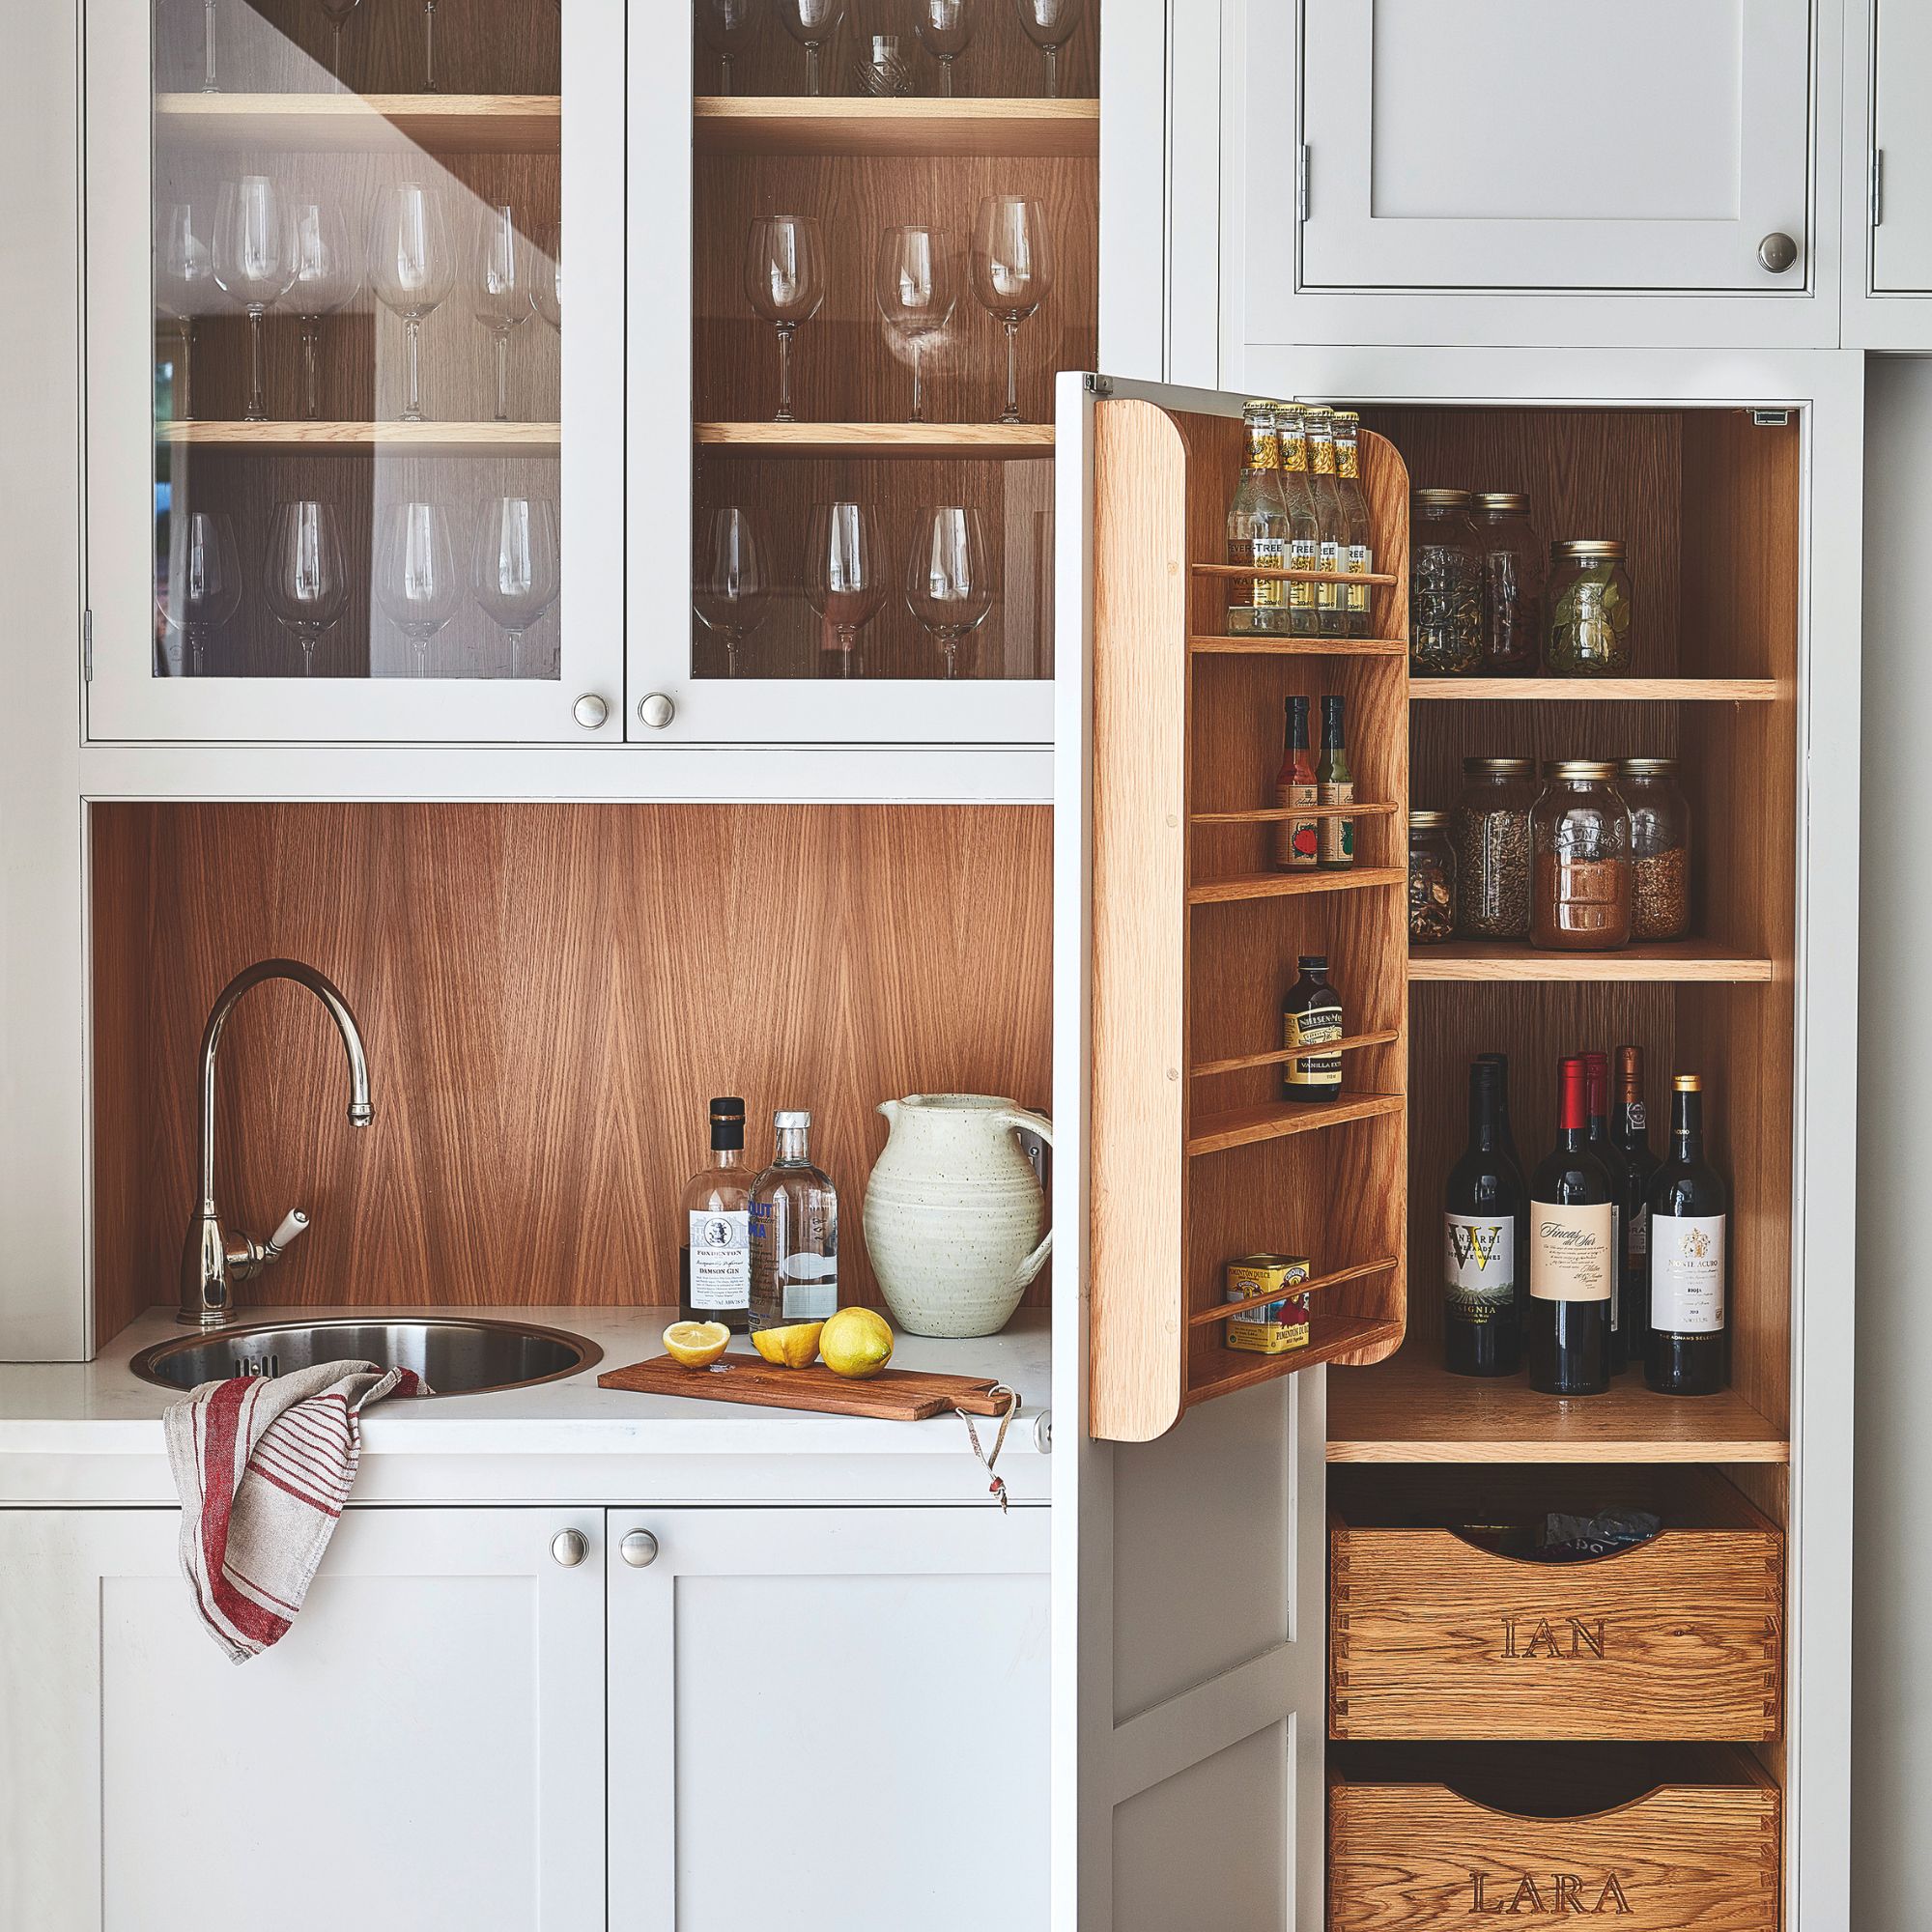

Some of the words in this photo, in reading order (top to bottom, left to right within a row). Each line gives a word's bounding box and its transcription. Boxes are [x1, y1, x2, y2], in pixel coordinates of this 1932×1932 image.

[1540, 1221, 1581, 1239] Fincas
[1574, 1233, 1597, 1247] Sur
[1500, 1616, 1609, 1660] IAN
[1467, 1871, 1634, 1915] LARA
